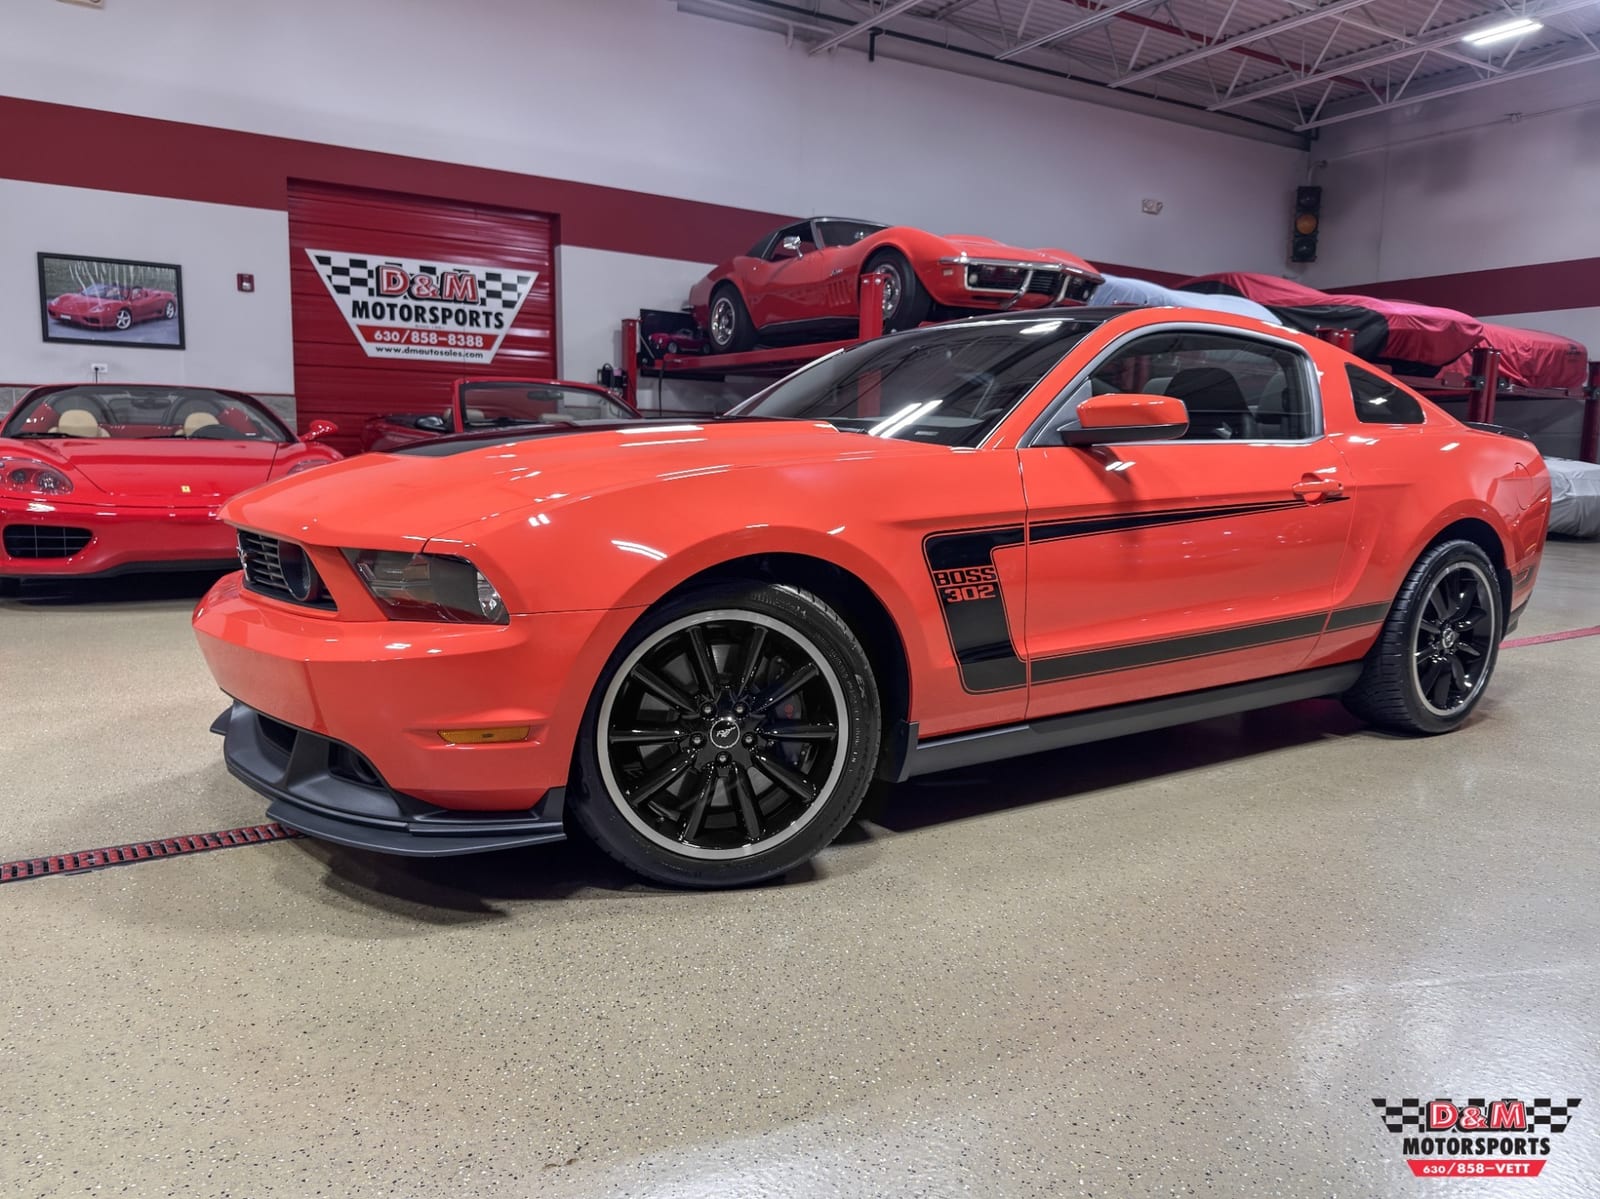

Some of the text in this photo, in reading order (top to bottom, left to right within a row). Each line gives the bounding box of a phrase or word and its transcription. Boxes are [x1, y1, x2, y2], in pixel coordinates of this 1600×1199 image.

[377, 266, 479, 303] D&M
[352, 301, 504, 329] MOTORSPORTS
[374, 330, 484, 348] 630/858-8388
[375, 346, 484, 359] www.dmautosales.com
[935, 568, 997, 586] BOSS
[944, 585, 996, 603] 302
